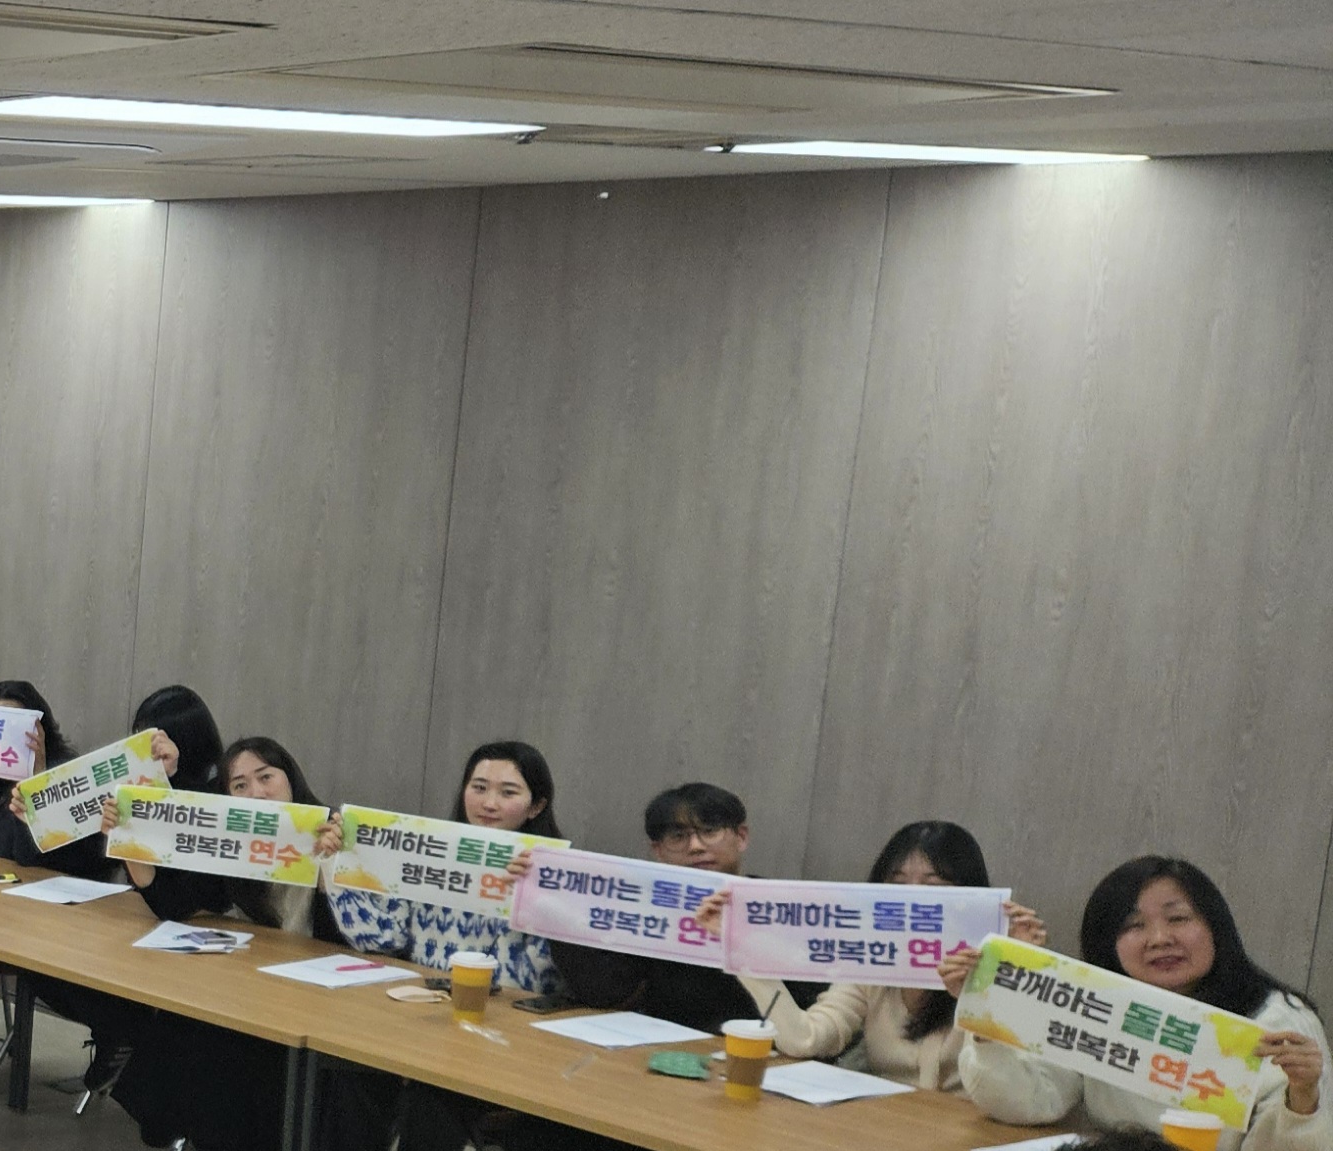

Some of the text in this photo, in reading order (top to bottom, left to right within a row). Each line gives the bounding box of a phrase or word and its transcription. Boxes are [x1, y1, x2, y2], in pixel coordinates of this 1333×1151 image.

[31, 752, 130, 811] 함께하는 돌봄
[131, 799, 280, 837] 함께하는 돌봄
[175, 832, 302, 869] 행복한 연수
[356, 824, 514, 870] 함께하는 돌봄
[402, 862, 513, 901] 행복한 연
[538, 865, 642, 903] 함께하는
[589, 906, 720, 946] 행복한 연
[746, 898, 944, 933] 함께하는 돌봄
[807, 936, 897, 966] 행복한
[994, 958, 1201, 1055] 함께하는 돌봄
[1045, 1021, 1227, 1108] 행복한 연수
